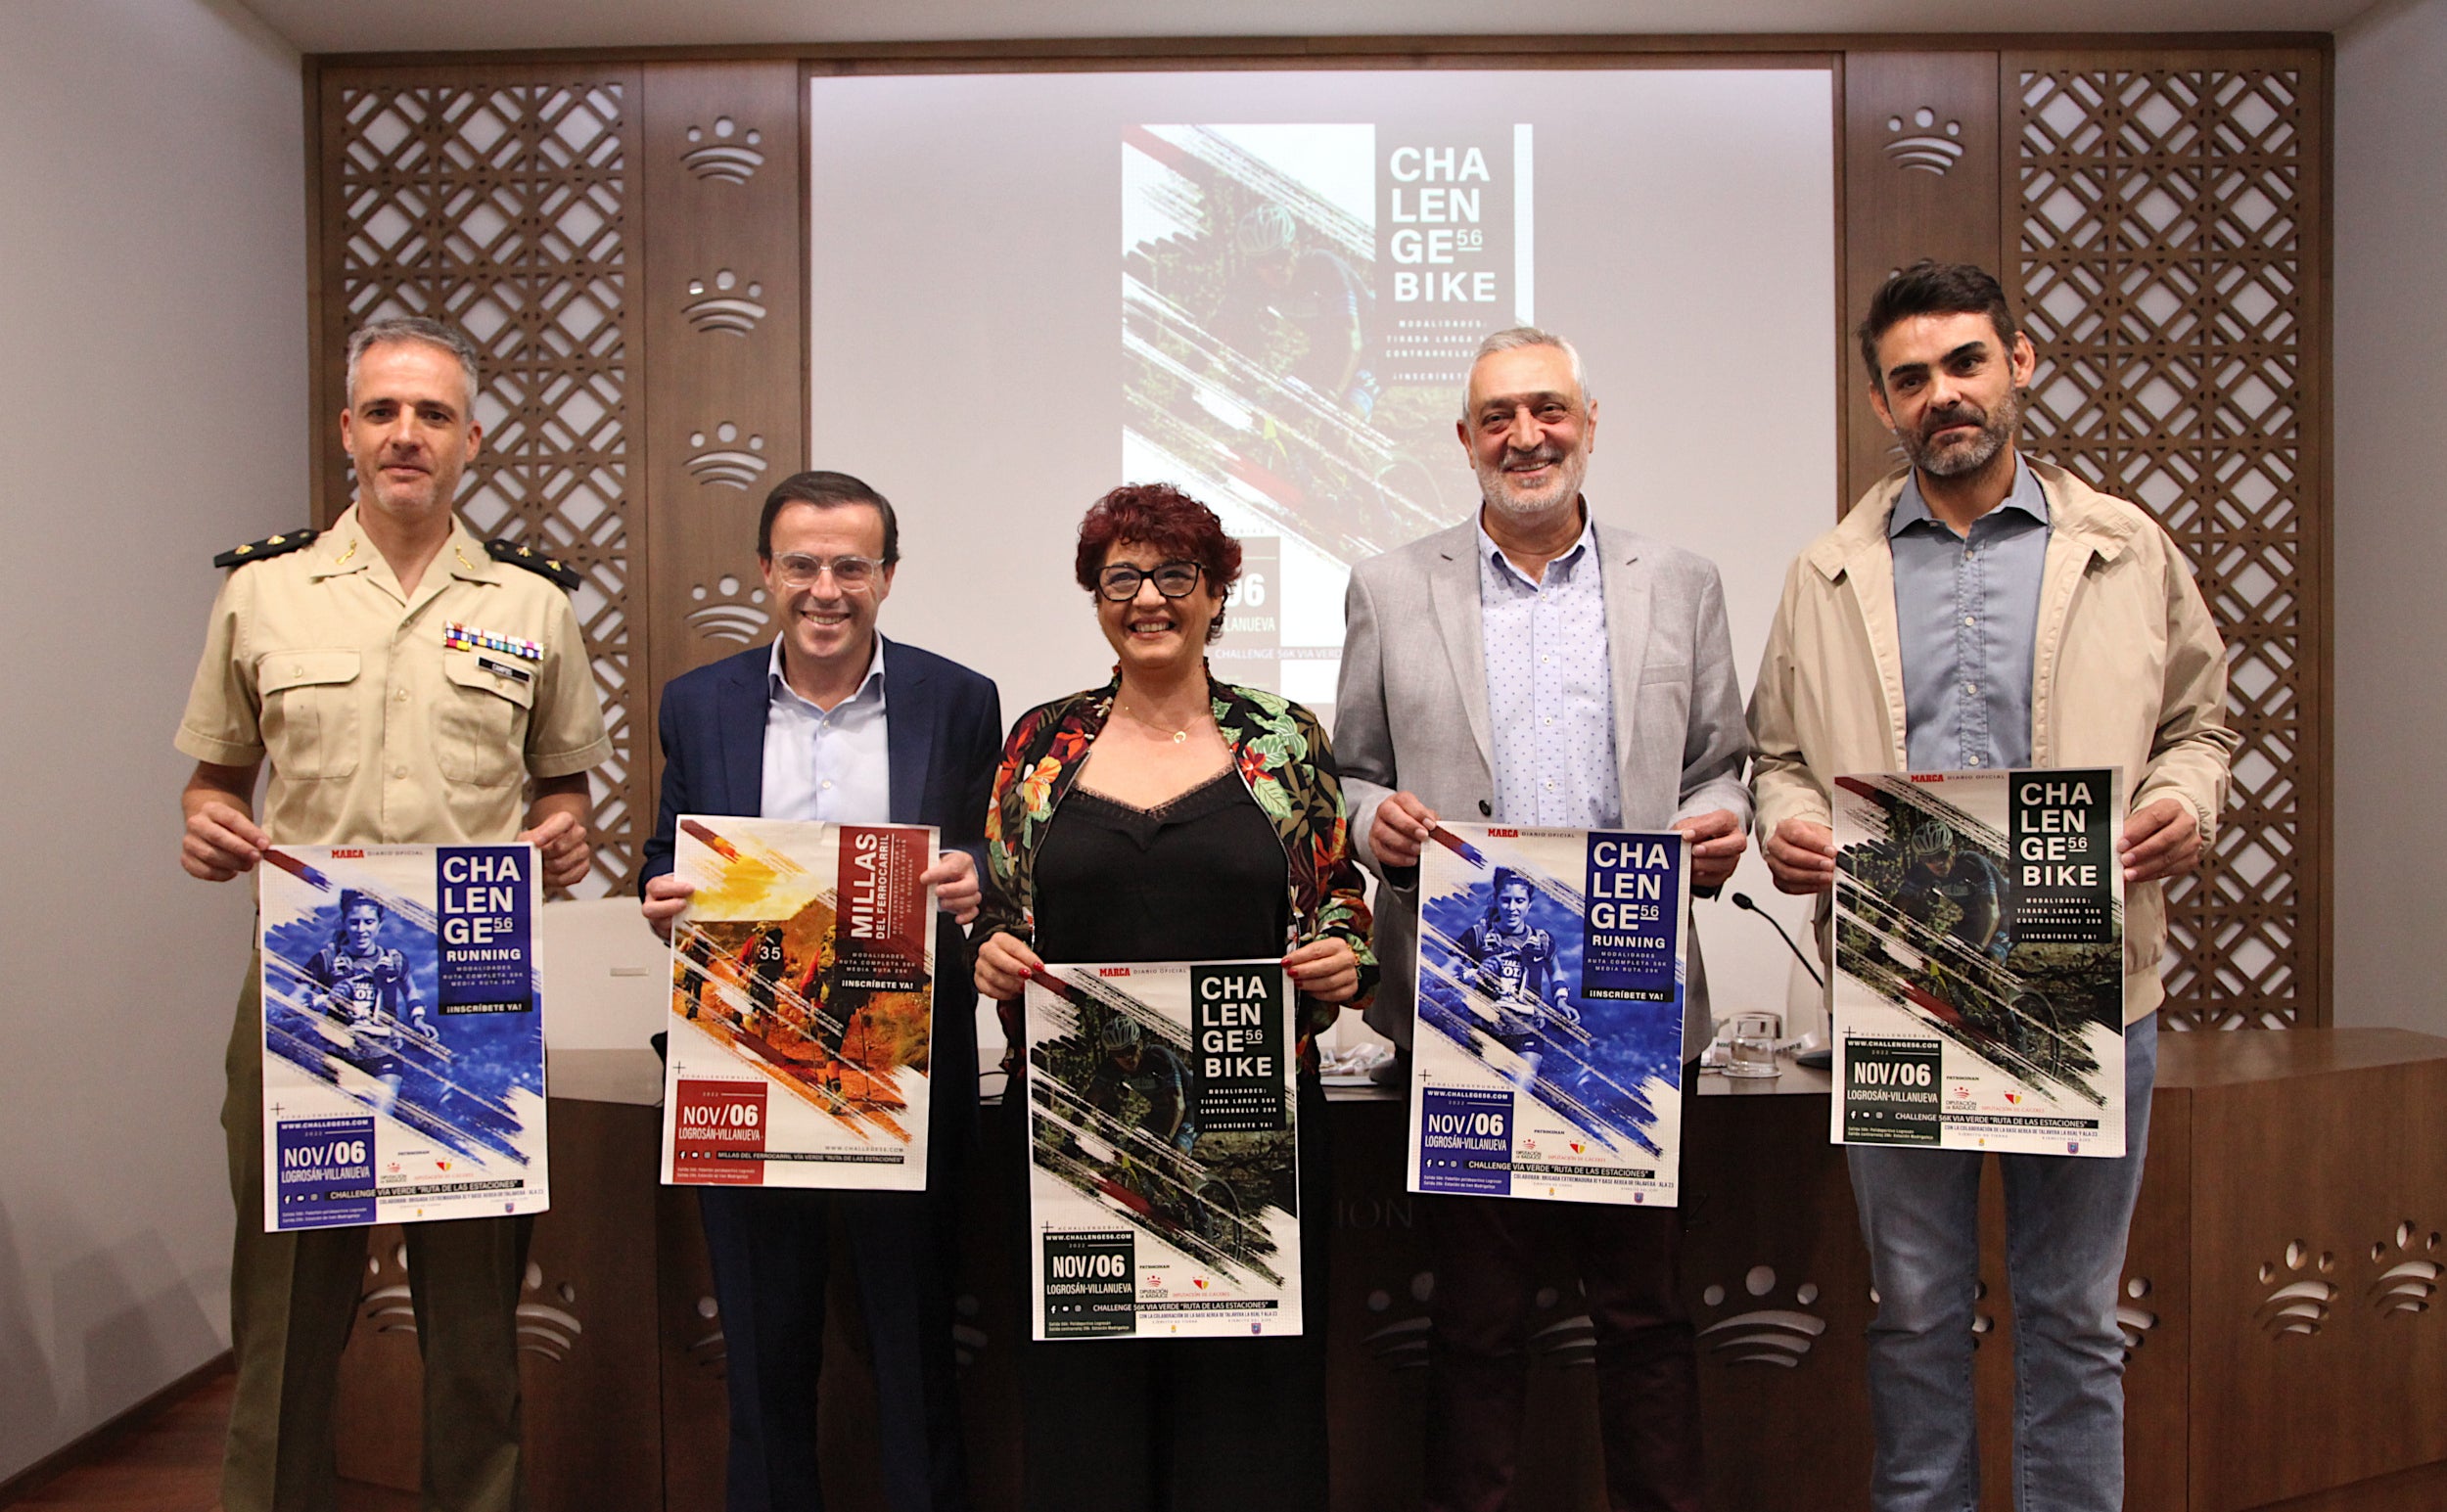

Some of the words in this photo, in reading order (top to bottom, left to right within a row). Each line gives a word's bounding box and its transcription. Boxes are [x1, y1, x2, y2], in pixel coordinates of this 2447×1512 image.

[1389, 146, 1491, 182] CHA
[1391, 188, 1480, 223] LEN
[1390, 229, 1454, 264] GE
[1455, 229, 1483, 247] 56
[1394, 271, 1497, 302] BIKE
[1215, 648, 1274, 660] CHALLENGE
[1911, 774, 1944, 783] MARCA
[2019, 782, 2094, 806] CHA
[2020, 808, 2086, 834] LEN
[1488, 828, 1519, 838] MARCA
[331, 849, 364, 859] MARCA
[1593, 841, 1670, 870] CHA
[2019, 836, 2067, 861] GE
[2067, 837, 2088, 849] 56
[442, 855, 522, 884] CHA
[877, 834, 890, 914] FERROCARRIL
[2022, 865, 2098, 887] BIKE
[851, 833, 878, 939] MILLAS
[1593, 871, 1661, 901] LEN
[443, 886, 513, 914] LEN
[1591, 901, 1639, 931] GE
[1639, 904, 1660, 917] 56
[443, 917, 494, 944] GE
[493, 917, 514, 931] 56
[875, 917, 886, 939] DEL
[1592, 934, 1666, 949] RUNNING
[445, 948, 522, 963] RUNNING
[760, 945, 781, 961] 35
[1099, 967, 1131, 978] MARCA
[842, 979, 898, 989] ¡INSCRÍBETE
[1200, 976, 1268, 1000] CHA
[1590, 989, 1646, 1000] ¡INSCRÍBETE
[1648, 992, 1664, 1001] YA!
[446, 1002, 505, 1014] ¡INSCRÍBETE
[506, 1003, 523, 1012] YA!
[1202, 1002, 1262, 1027] LEN
[1202, 1030, 1245, 1054] GE
[1245, 1030, 1264, 1041] 56
[1847, 1040, 1939, 1049] WWW.CHALLENGE56.COM
[1205, 1056, 1272, 1078] BIKE
[1854, 1061, 1932, 1087] NOV/06
[1847, 1088, 1939, 1104] LOGROSÁN-VILLANUEVA
[682, 1103, 759, 1127] NOV/06
[1428, 1112, 1504, 1137] NOV/06
[1895, 1112, 1937, 1122] CHALLENGE
[2039, 1119, 2088, 1128] ESTACIONES"
[678, 1125, 761, 1142] LOGROSÁN-VILLANUEVA
[1424, 1133, 1507, 1152] LOGROSÁN-VILLANUEVA
[284, 1140, 366, 1168] NOV/06
[281, 1165, 371, 1184] LOGROSÁN-VILLANUEVA
[1468, 1160, 1512, 1170] CHALLENGE
[1512, 1163, 1526, 1171] VÍA
[1526, 1164, 1549, 1172] VERDE
[1585, 1167, 1600, 1175] LAS
[1600, 1168, 1649, 1178] ESTACIONES"
[330, 1188, 377, 1200] CHALLENGE
[391, 1185, 416, 1196] VERDE
[440, 1184, 452, 1193] DE
[452, 1182, 468, 1192] LAS
[1052, 1254, 1126, 1279] NOV/06
[1046, 1282, 1132, 1295] LOGROSÁN-VILLANUEVA
[1132, 1303, 1146, 1311] 56K
[1179, 1302, 1200, 1310] "RUTA
[1225, 1301, 1270, 1309] ESTACIONES"
